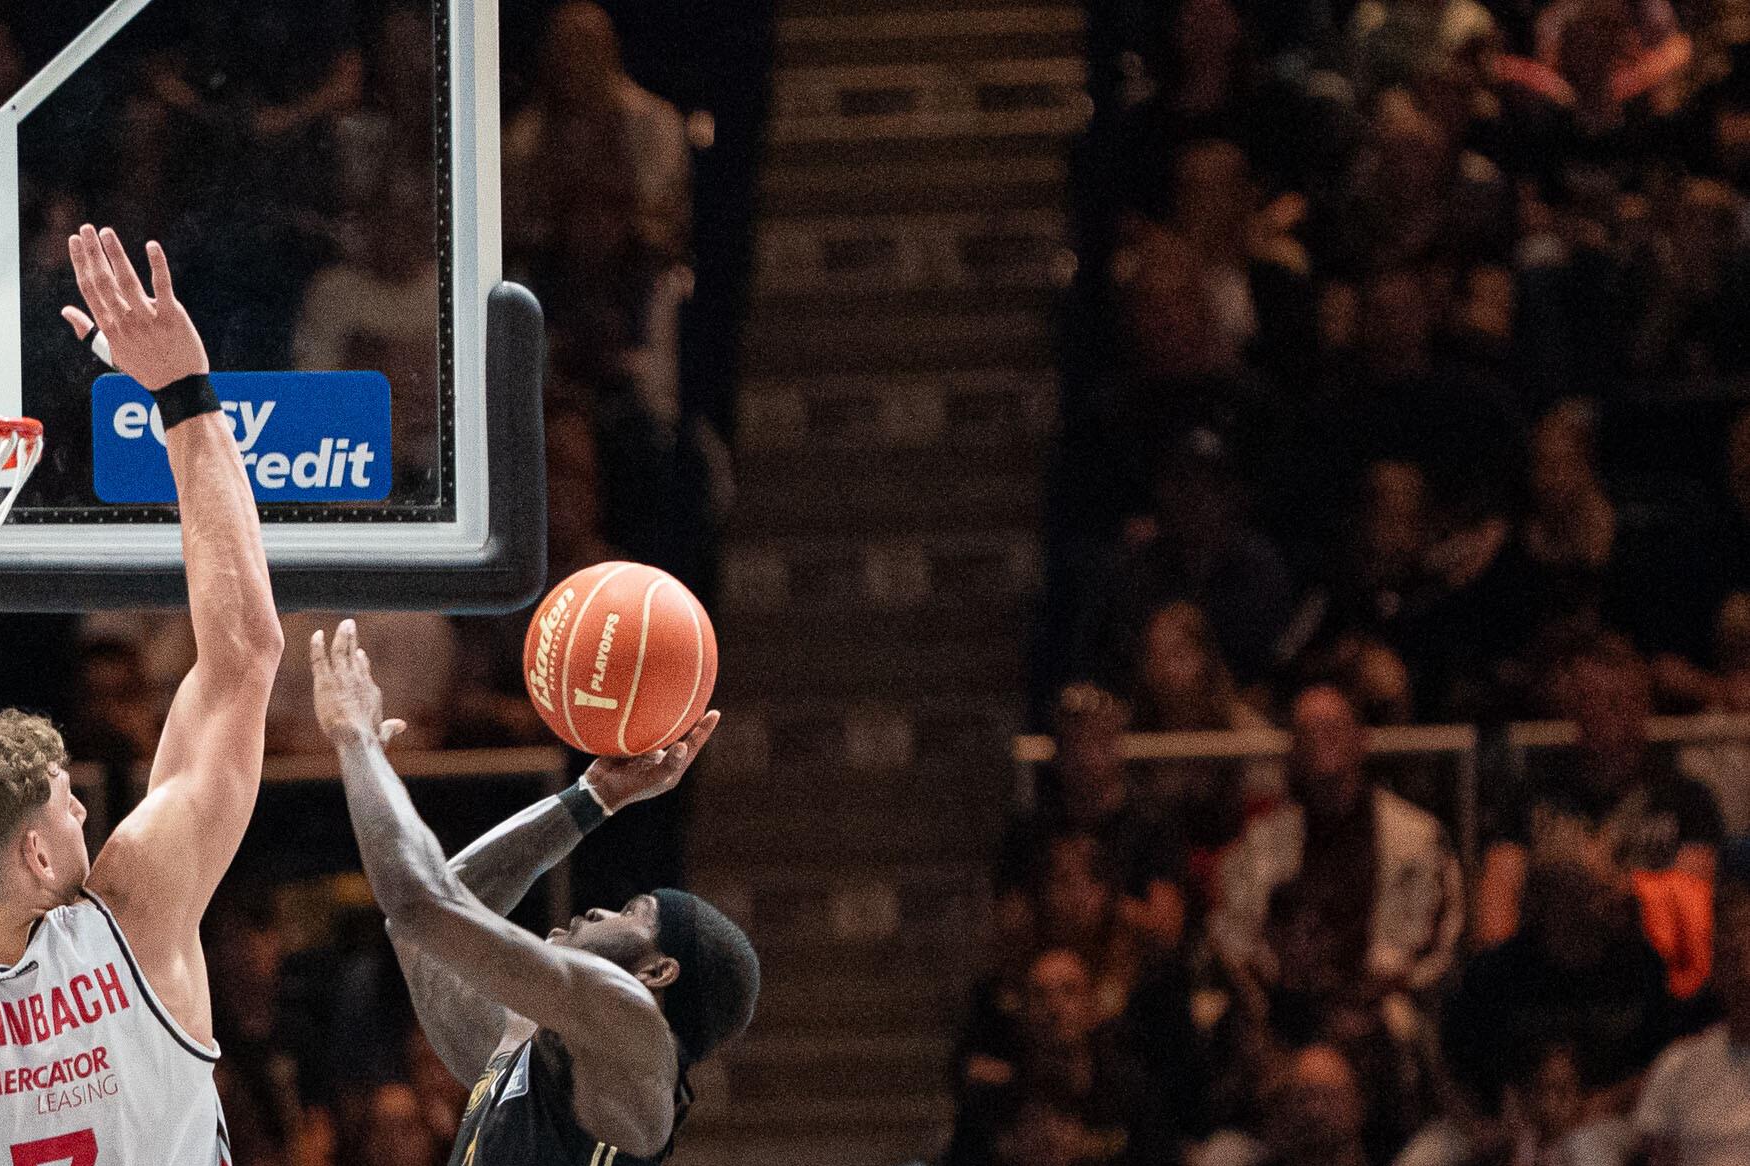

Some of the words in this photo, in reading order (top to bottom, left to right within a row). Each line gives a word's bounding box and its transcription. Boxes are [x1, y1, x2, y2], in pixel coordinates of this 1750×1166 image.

[240, 437, 375, 488] redit
[529, 587, 576, 713] Baden
[590, 612, 621, 692] PLAYOFFS
[37, 1074, 119, 1116] LEASING
